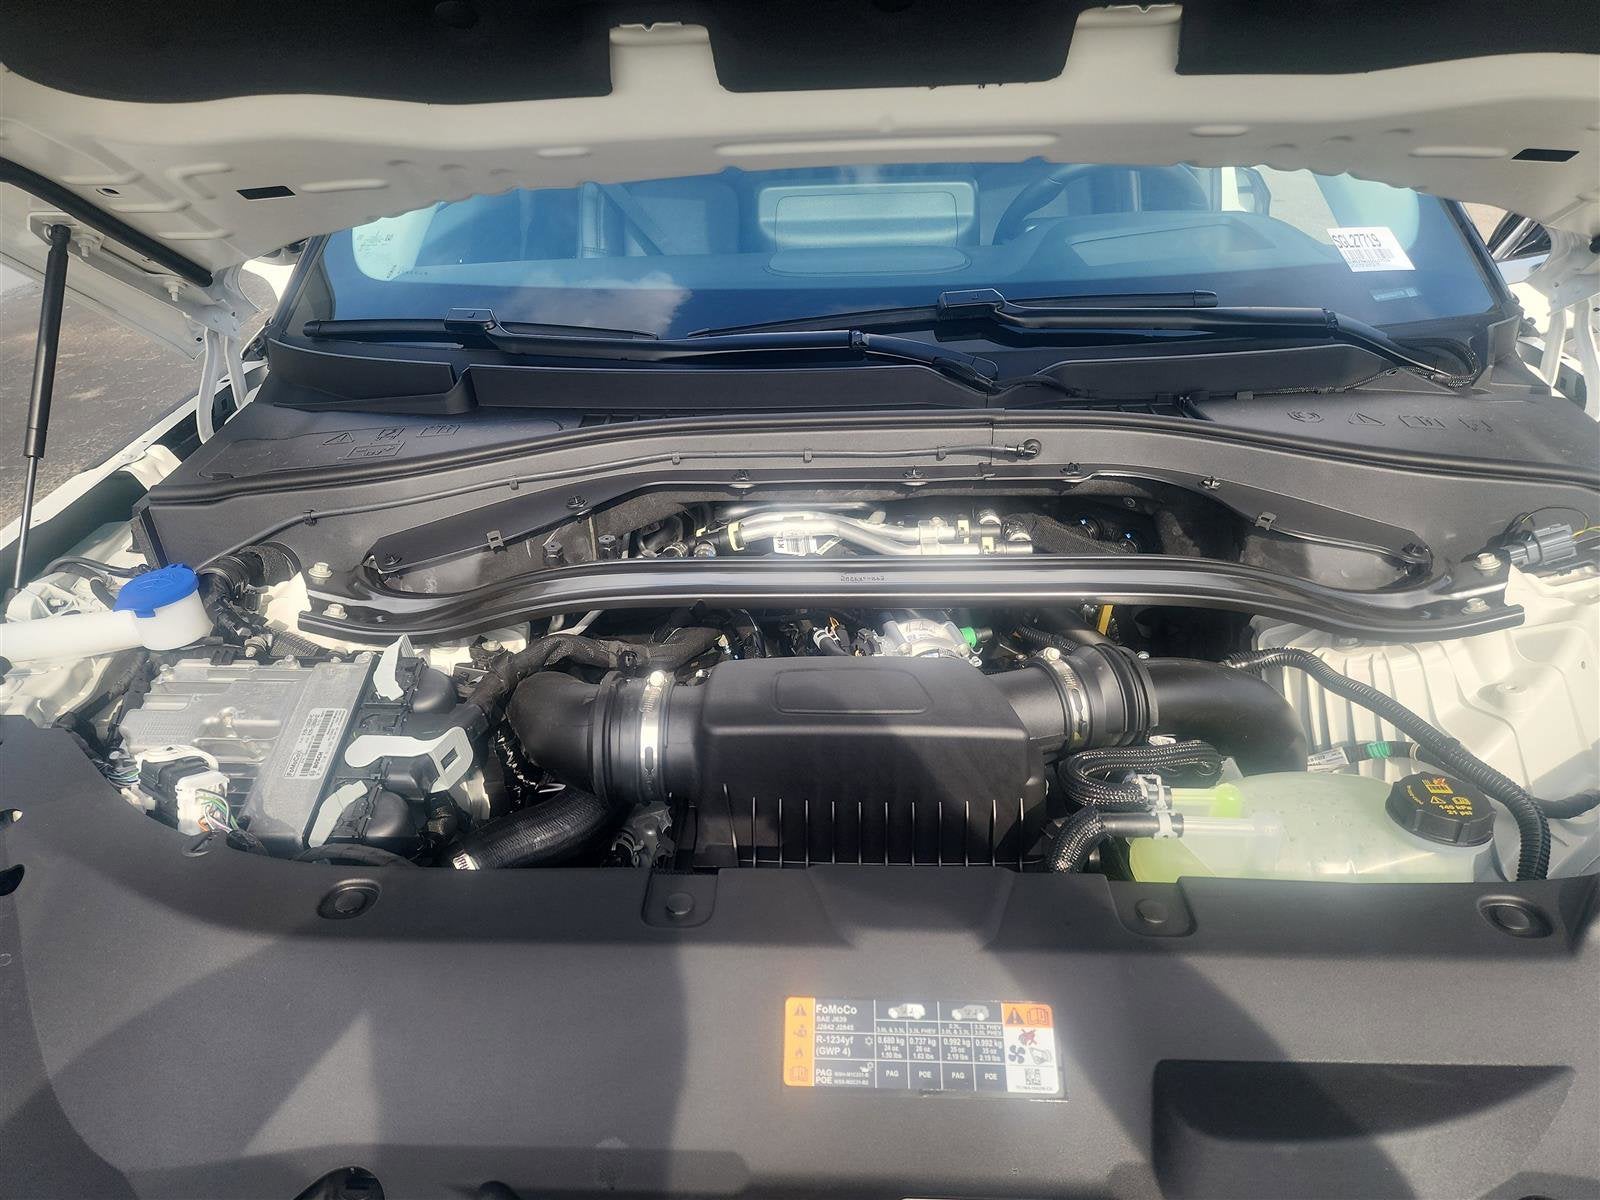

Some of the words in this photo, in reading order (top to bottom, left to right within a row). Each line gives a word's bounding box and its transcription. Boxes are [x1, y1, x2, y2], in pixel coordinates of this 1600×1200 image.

[312, 752, 323, 769] BOSCH
[815, 1004, 858, 1015] FoMoCo
[815, 1036, 854, 1046] R-1234yf
[896, 1037, 905, 1046] kg
[909, 1037, 927, 1045] 0.737
[927, 1038, 937, 1047] kg
[943, 1038, 962, 1046] 0.992
[962, 1039, 971, 1048] kg
[994, 1040, 1003, 1049] kg
[815, 1047, 840, 1056] (GWP
[842, 1047, 851, 1057] 4)
[815, 1068, 833, 1077] PAG
[815, 1076, 833, 1084] POE
